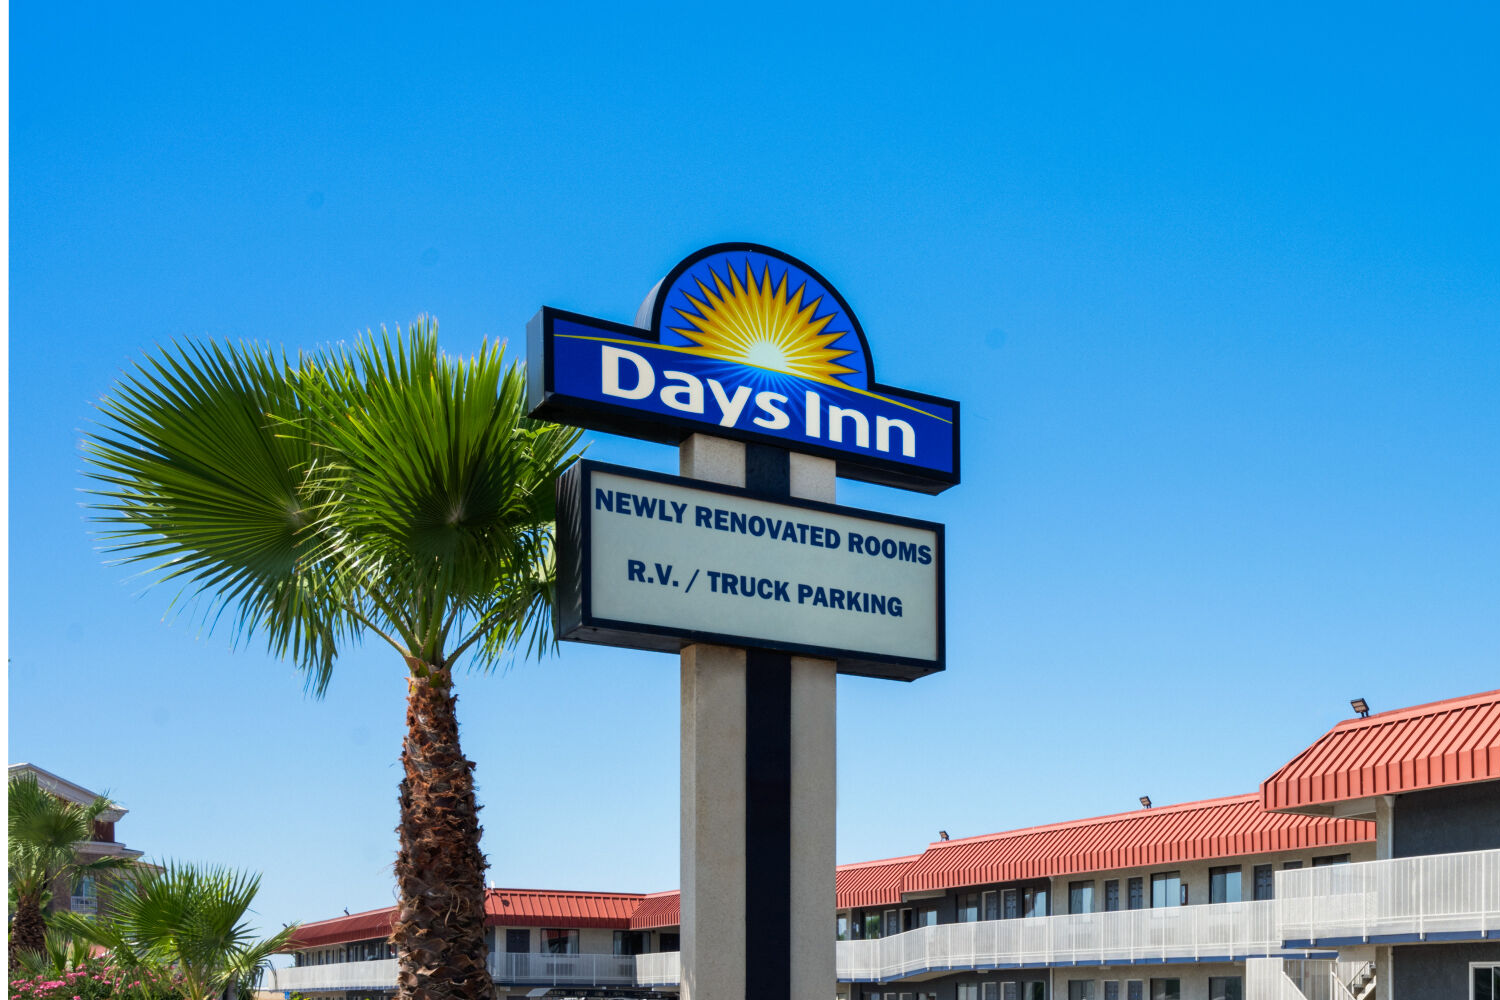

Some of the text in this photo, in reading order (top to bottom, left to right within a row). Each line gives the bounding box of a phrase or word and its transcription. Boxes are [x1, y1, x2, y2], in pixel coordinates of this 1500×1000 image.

[601, 345, 916, 458] Days Inn
[595, 488, 932, 565] NEWLY RENOVATED ROOMS
[627, 559, 903, 617] R.V. / TRUCK PARKING
